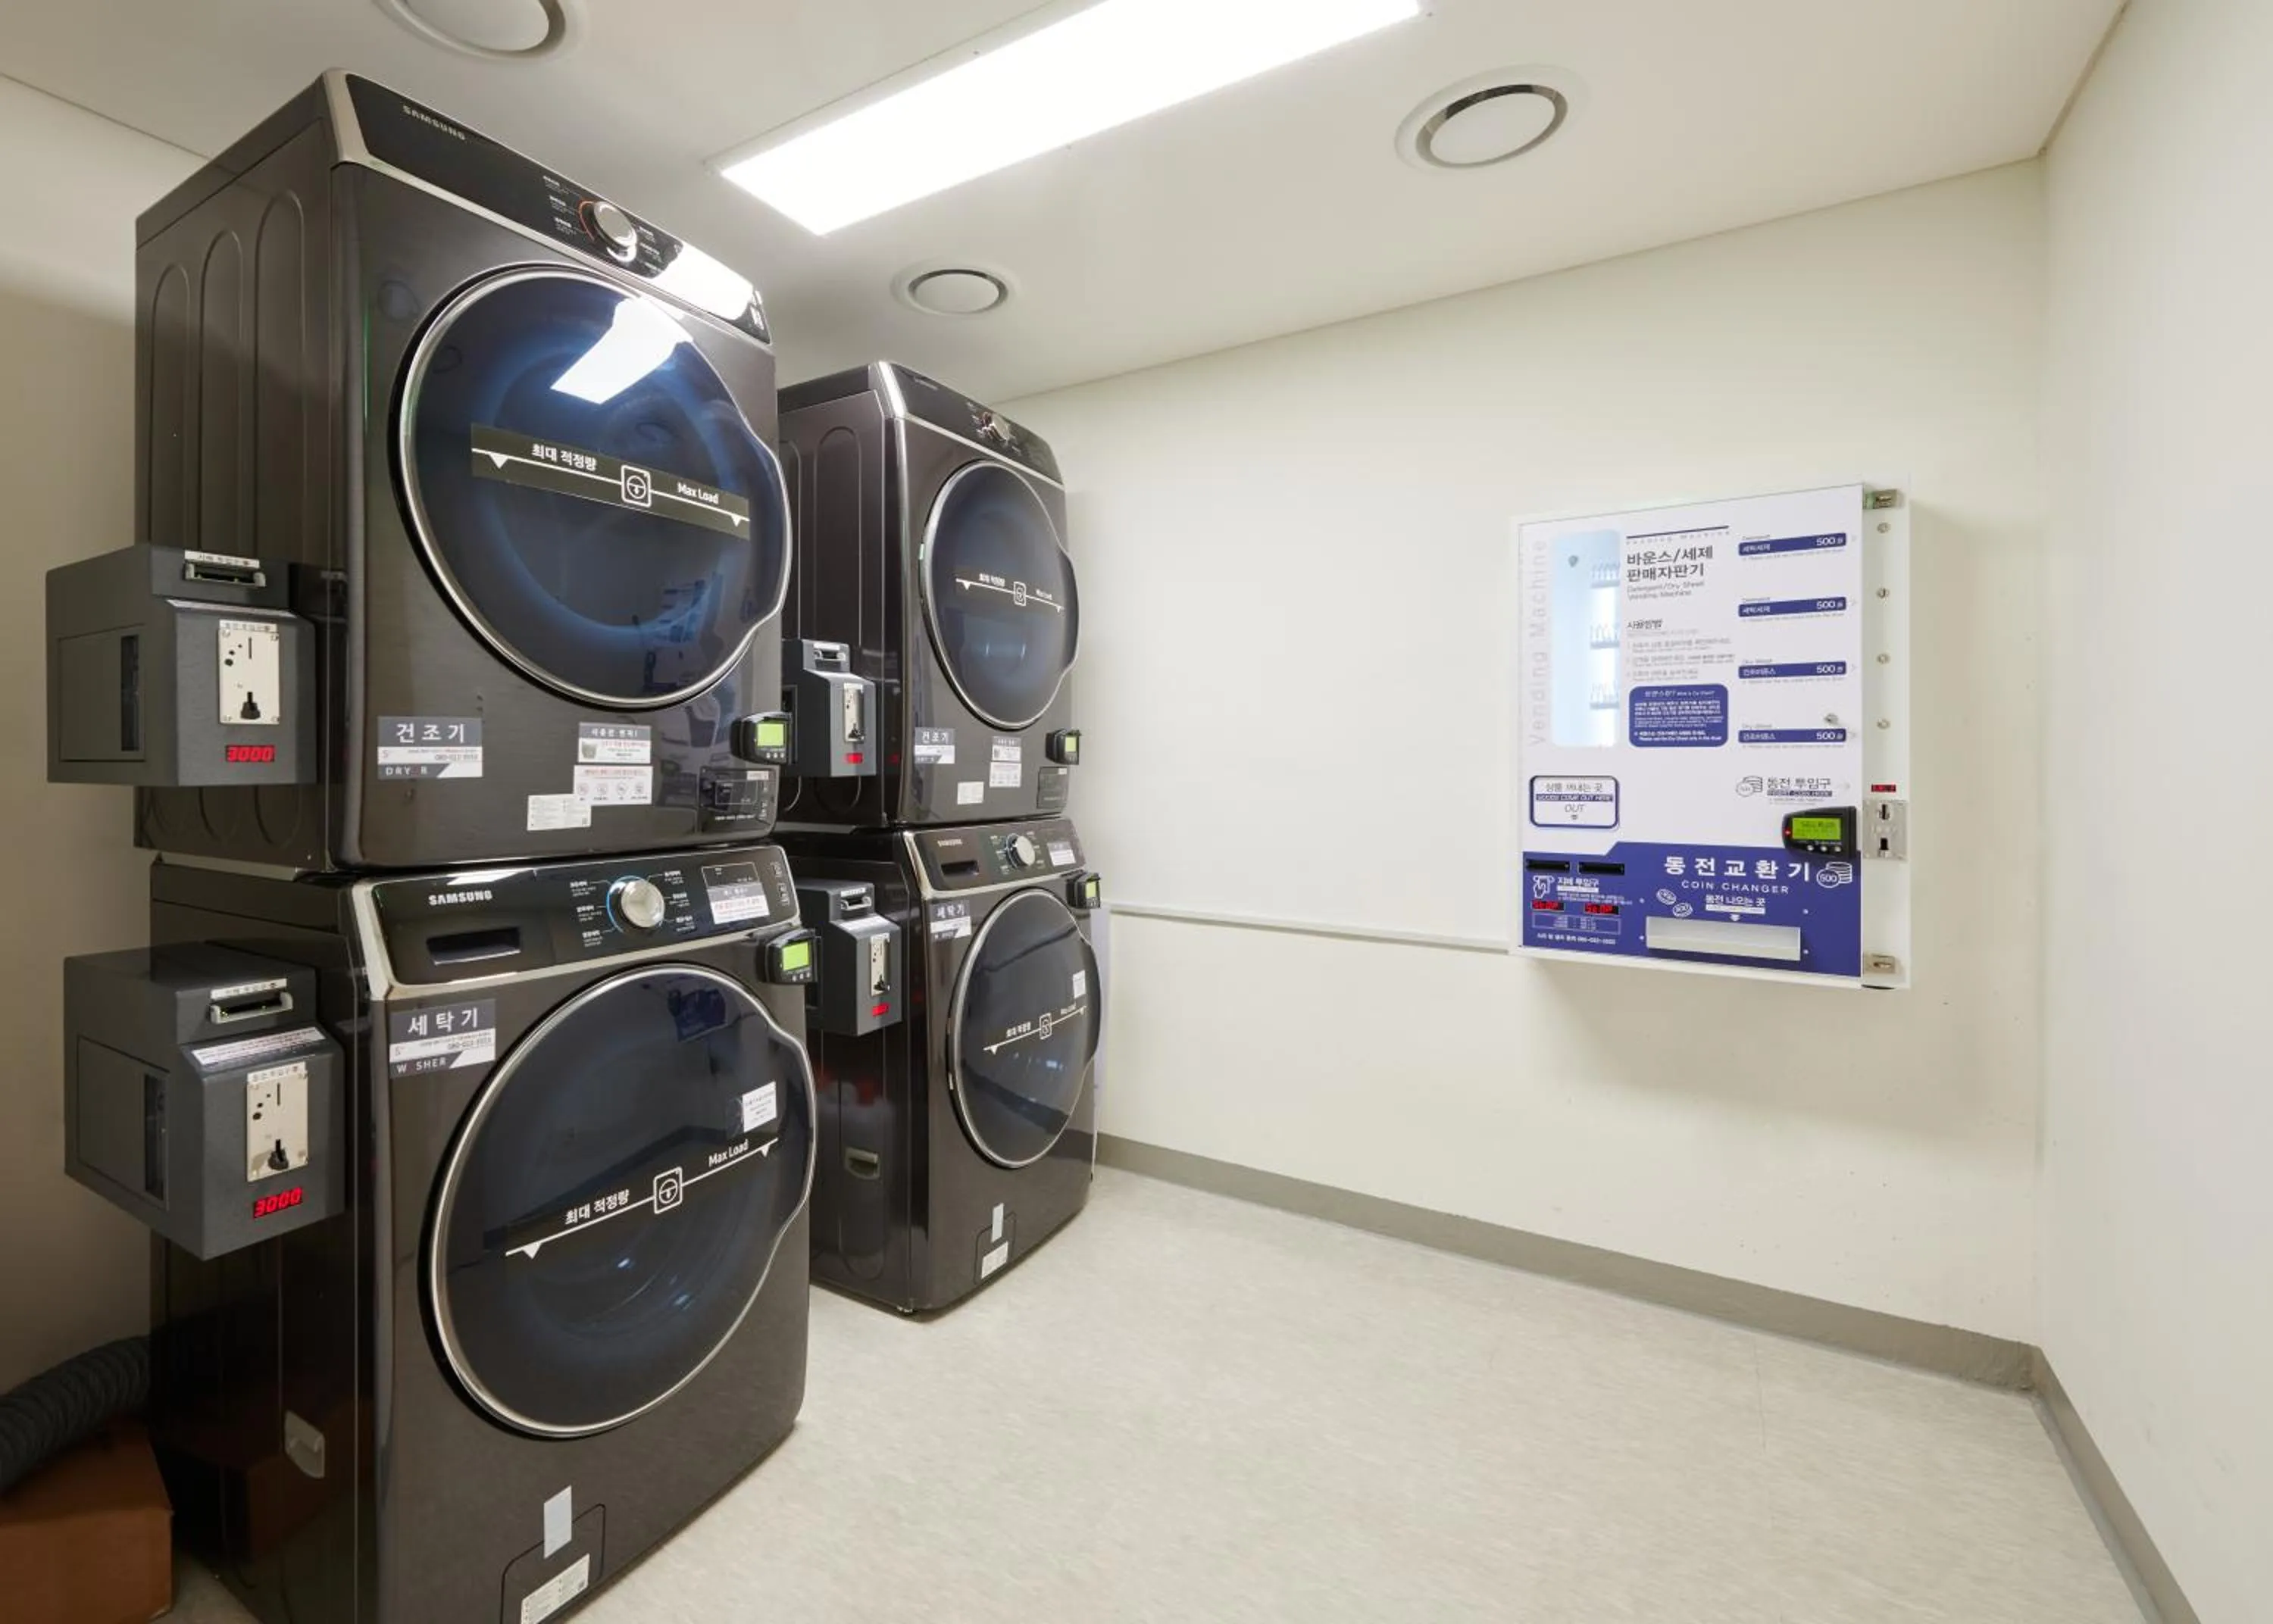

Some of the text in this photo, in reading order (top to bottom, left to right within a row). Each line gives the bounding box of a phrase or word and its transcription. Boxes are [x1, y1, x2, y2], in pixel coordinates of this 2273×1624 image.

[532, 444, 598, 472] 최대 적정량
[677, 481, 720, 505] Max Load
[1816, 536, 1836, 546] 500
[1627, 545, 1713, 565] 바운스/세제
[1626, 563, 1704, 582] 판매자판기
[1816, 601, 1836, 610] 500
[1816, 664, 1836, 673] 500
[396, 722, 465, 744] 건조기
[1816, 732, 1836, 740] 500
[227, 745, 274, 762] 3000
[1664, 855, 1810, 882] 동전교환기
[1820, 874, 1838, 882] 500
[1681, 879, 1790, 894] COIN CHANGER
[428, 889, 493, 906] SAMSUNG
[407, 1007, 478, 1036] 세탁기
[708, 1138, 750, 1168] Max Load
[254, 1186, 302, 1218] 3000
[564, 1188, 630, 1226] 최대 적정량
